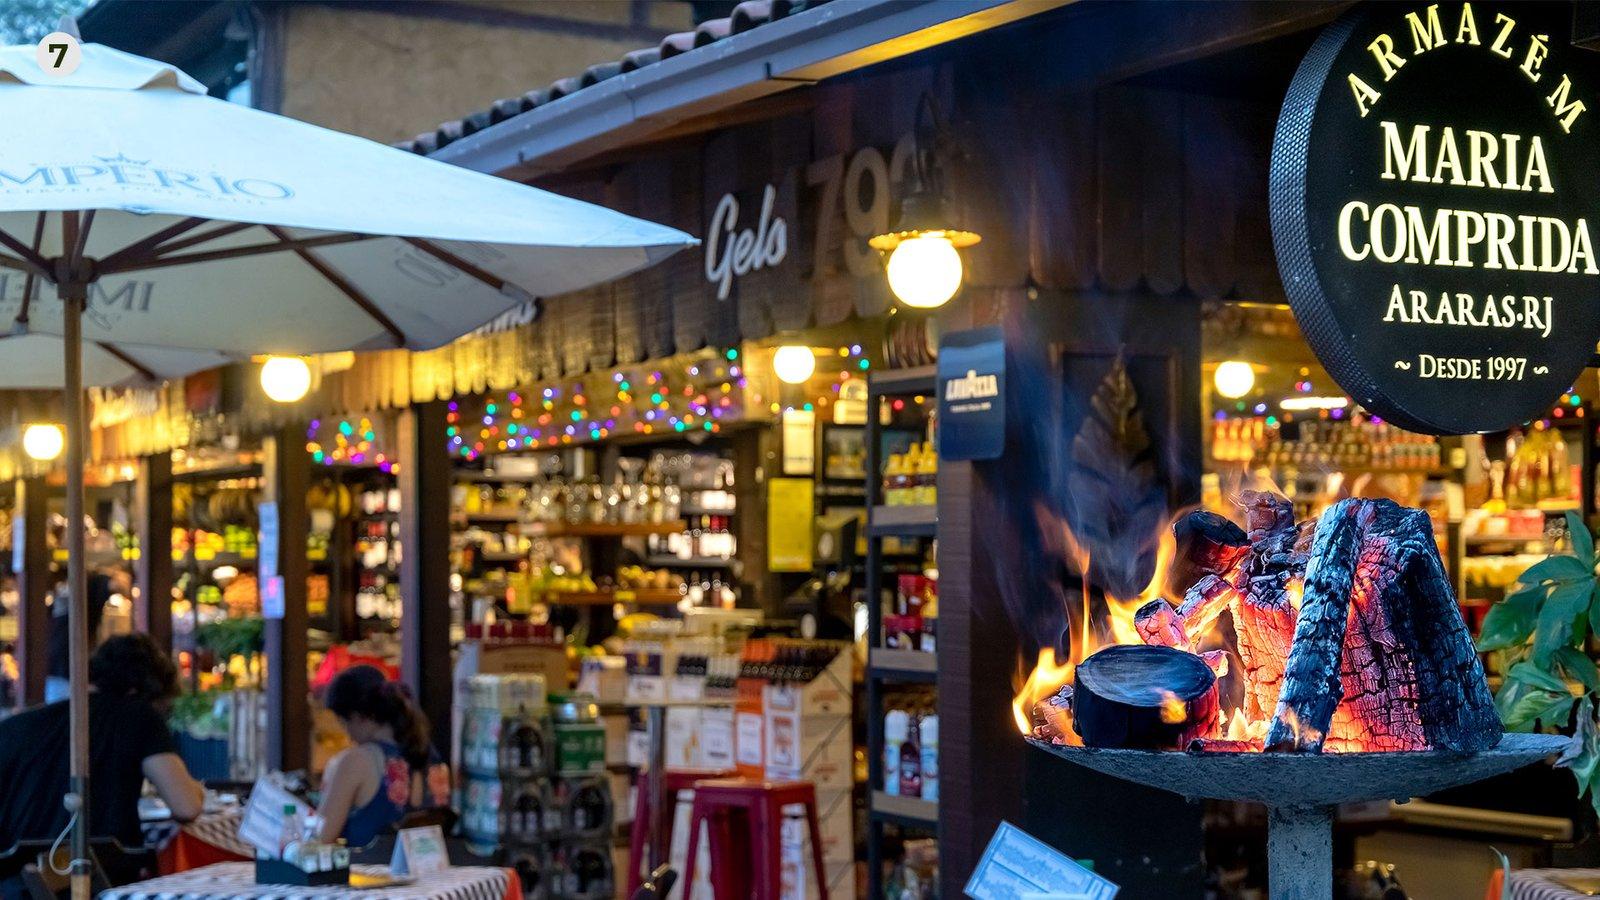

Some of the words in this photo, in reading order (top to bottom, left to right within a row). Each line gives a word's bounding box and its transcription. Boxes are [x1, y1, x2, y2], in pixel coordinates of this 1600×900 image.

[1347, 2, 1587, 135] ARMAZÉM
[1380, 120, 1554, 194] MARIA
[1337, 200, 1600, 275] COMPRIDA
[1418, 354, 1482, 380] DESDE
[1486, 356, 1528, 381] 1997
